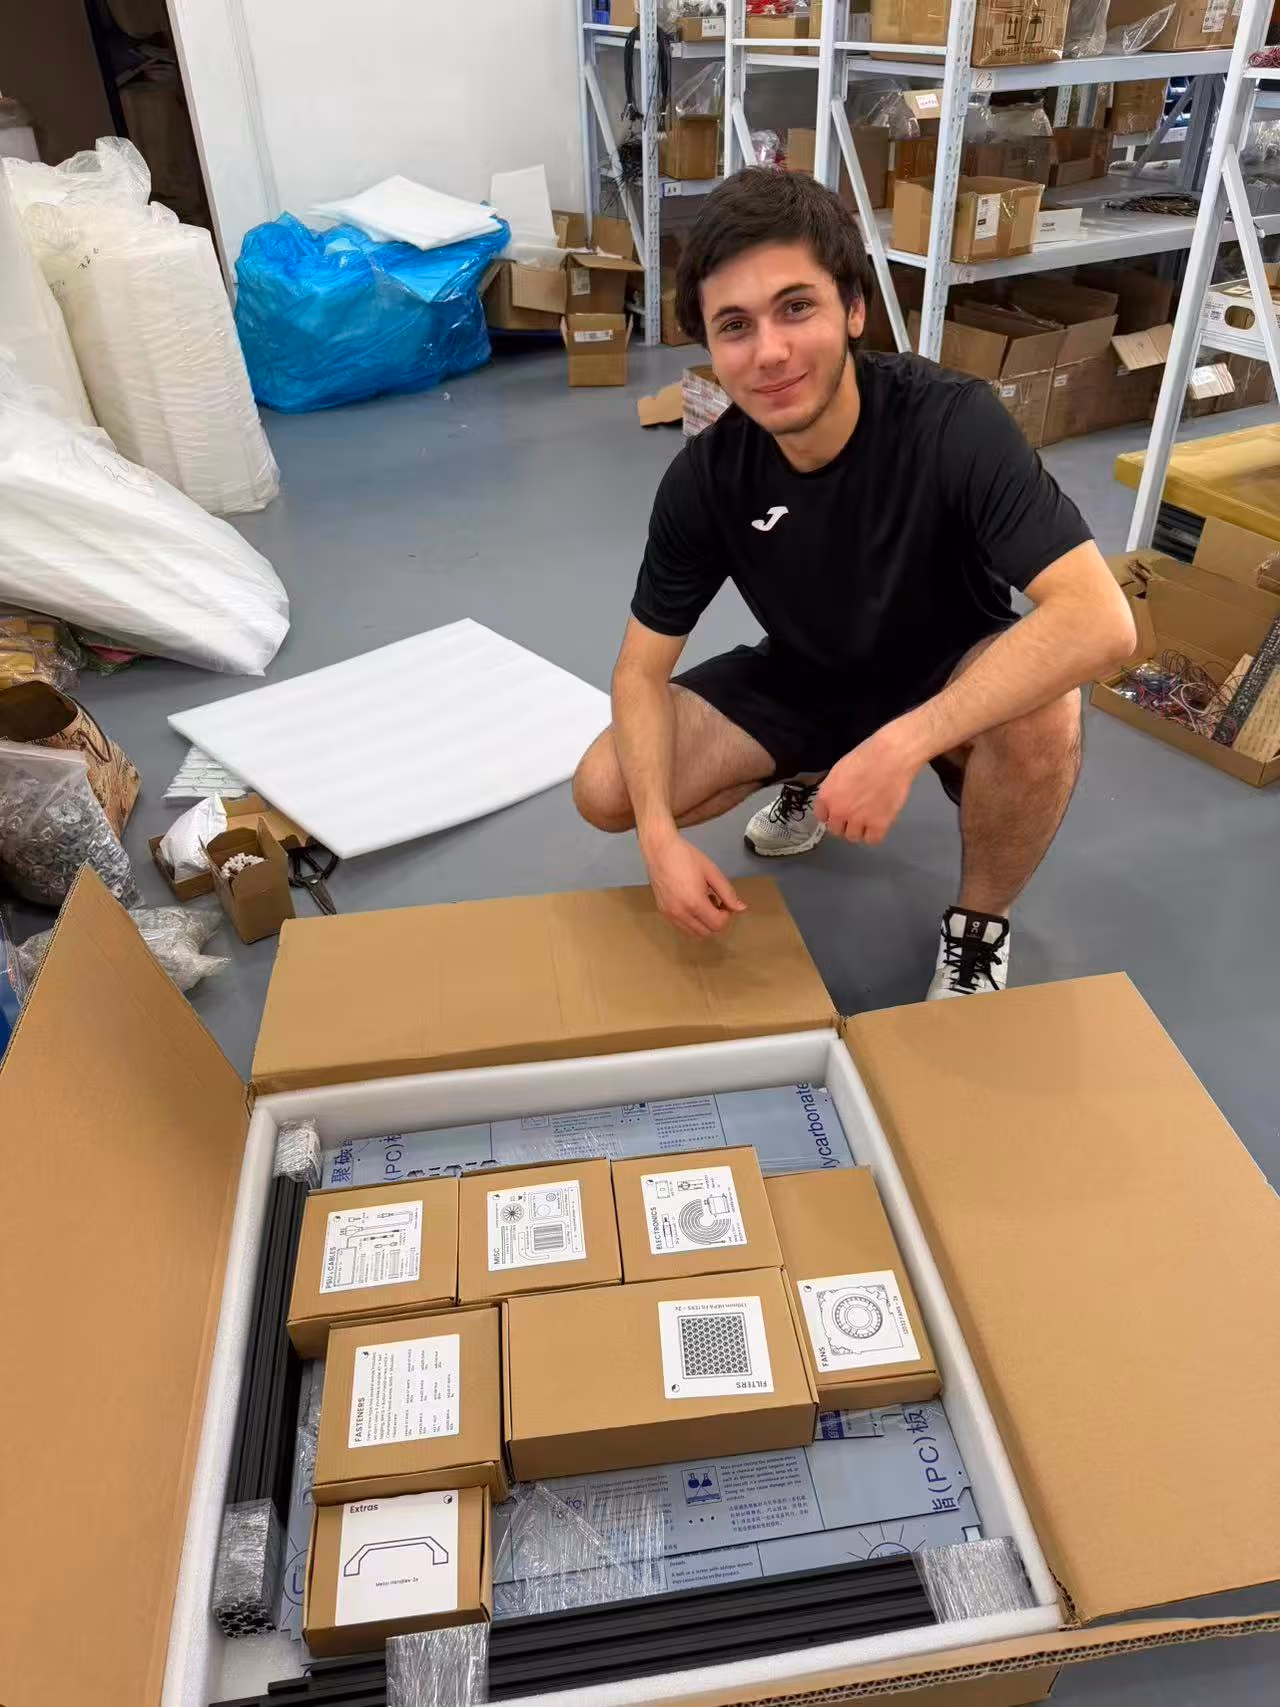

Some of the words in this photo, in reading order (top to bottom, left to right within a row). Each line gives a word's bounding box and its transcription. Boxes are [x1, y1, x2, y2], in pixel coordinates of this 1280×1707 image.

[650, 1206, 662, 1249] ELECTRONICS
[327, 1246, 336, 1271] CABLES
[895, 1305, 903, 1319] FANS
[817, 1346, 829, 1366] FANS
[735, 1380, 767, 1388] FILTERS
[354, 1397, 365, 1442] FASTENERS
[350, 1504, 378, 1513] Extras
